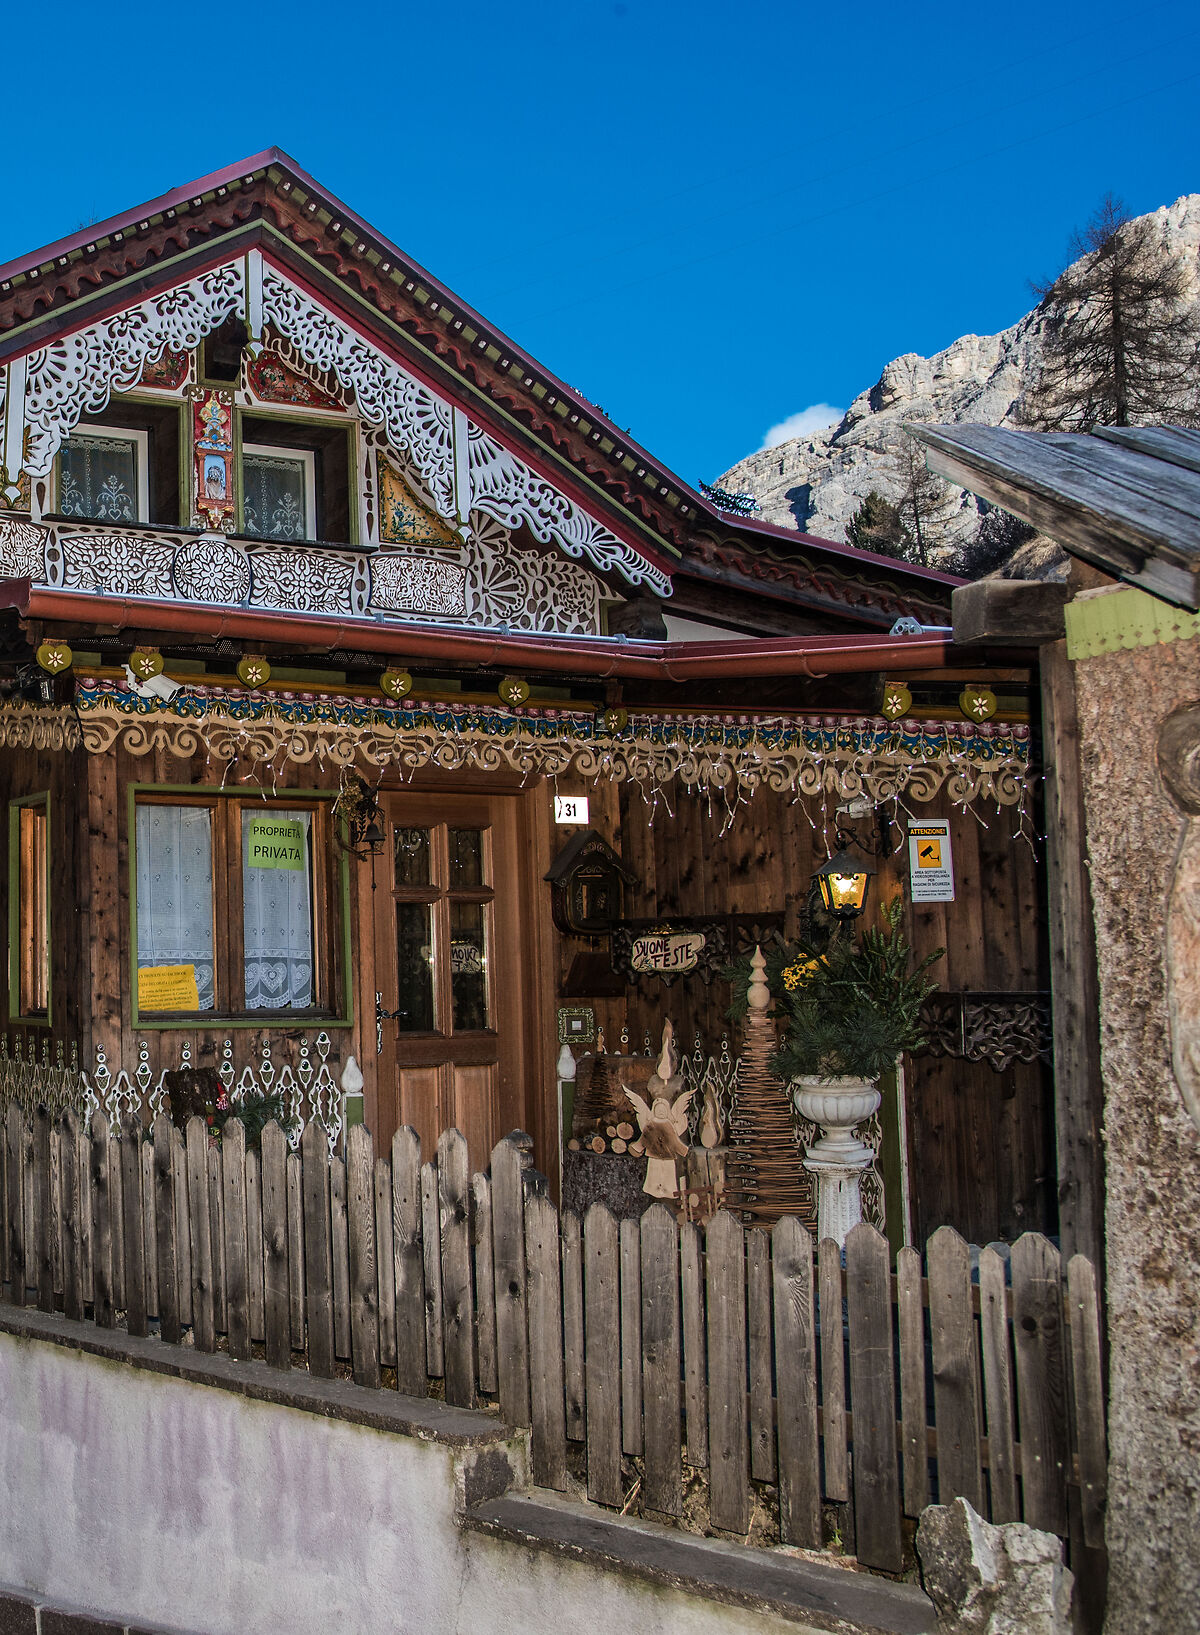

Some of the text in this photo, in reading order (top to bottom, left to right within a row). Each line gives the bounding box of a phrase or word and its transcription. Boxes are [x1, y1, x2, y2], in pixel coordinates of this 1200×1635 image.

[565, 803, 576, 816] 31
[254, 845, 301, 860] PRIVATA
[633, 938, 671, 962] BUONE
[651, 942, 693, 968] FESTE
